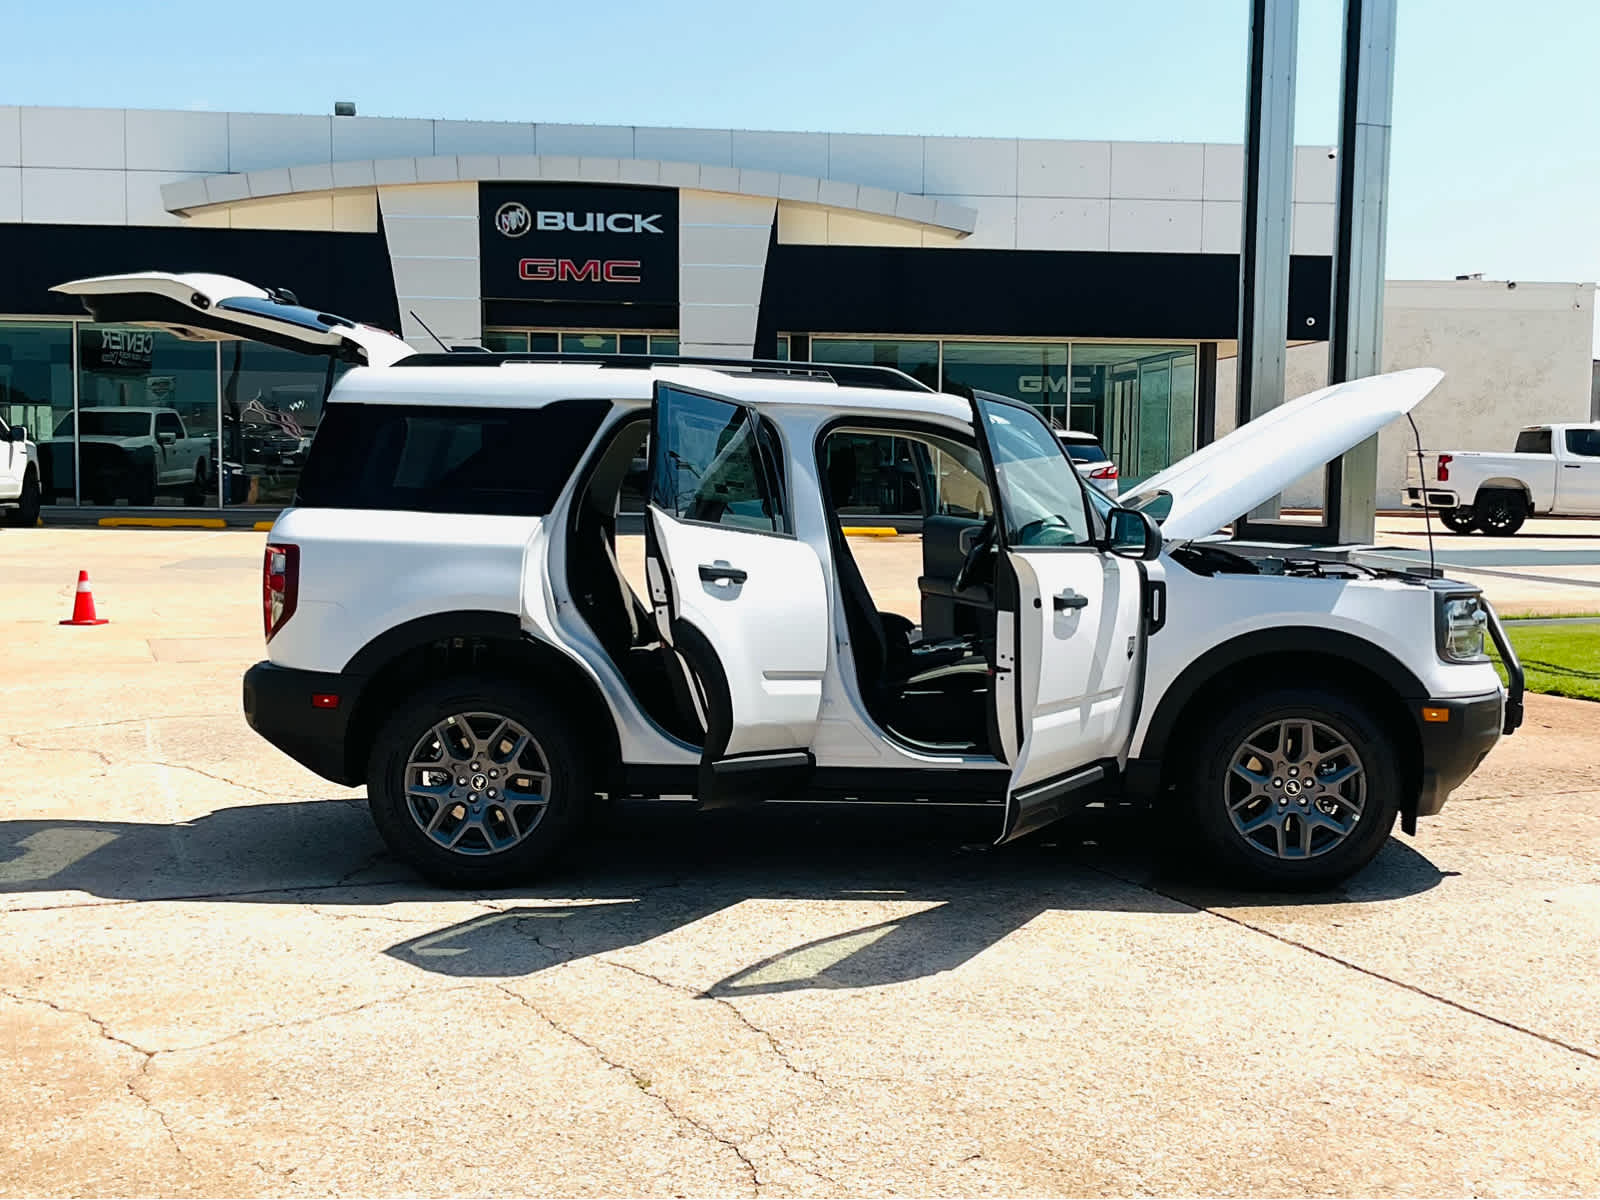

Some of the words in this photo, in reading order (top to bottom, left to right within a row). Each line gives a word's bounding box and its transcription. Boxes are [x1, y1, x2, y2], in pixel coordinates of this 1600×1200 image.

[536, 210, 664, 234] BUICK
[518, 258, 641, 283] GMC
[1018, 375, 1092, 393] GMC
